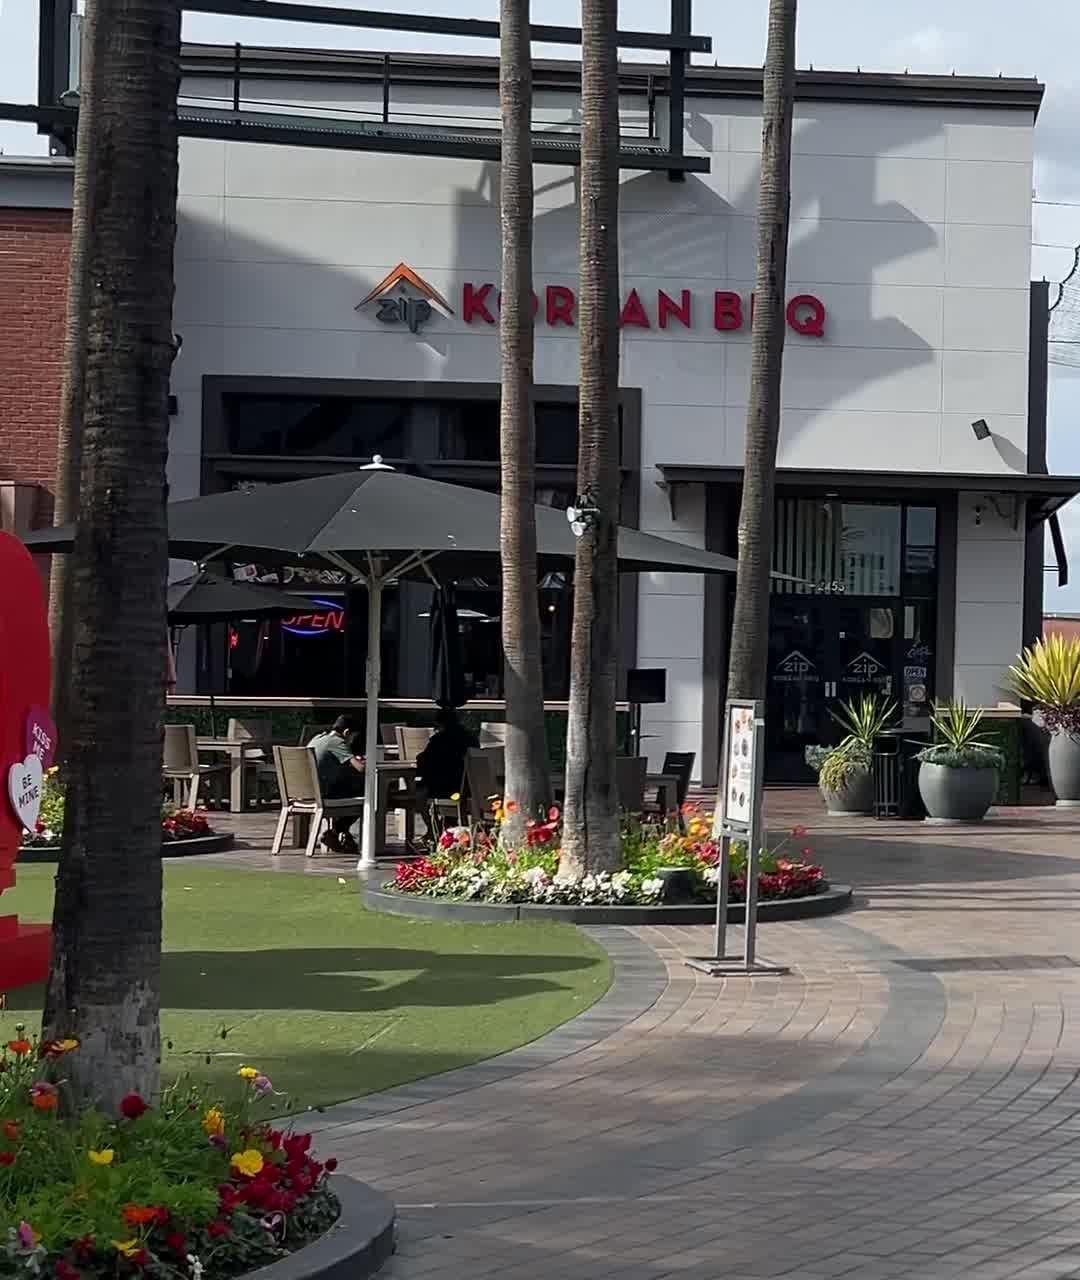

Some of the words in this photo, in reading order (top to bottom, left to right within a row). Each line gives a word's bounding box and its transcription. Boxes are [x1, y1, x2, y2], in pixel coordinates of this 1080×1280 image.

[376, 286, 432, 334] zip
[462, 282, 691, 329] KRAN
[714, 290, 826, 338] BQ
[19, 785, 40, 809] MINE
[22, 773, 33, 790] BE
